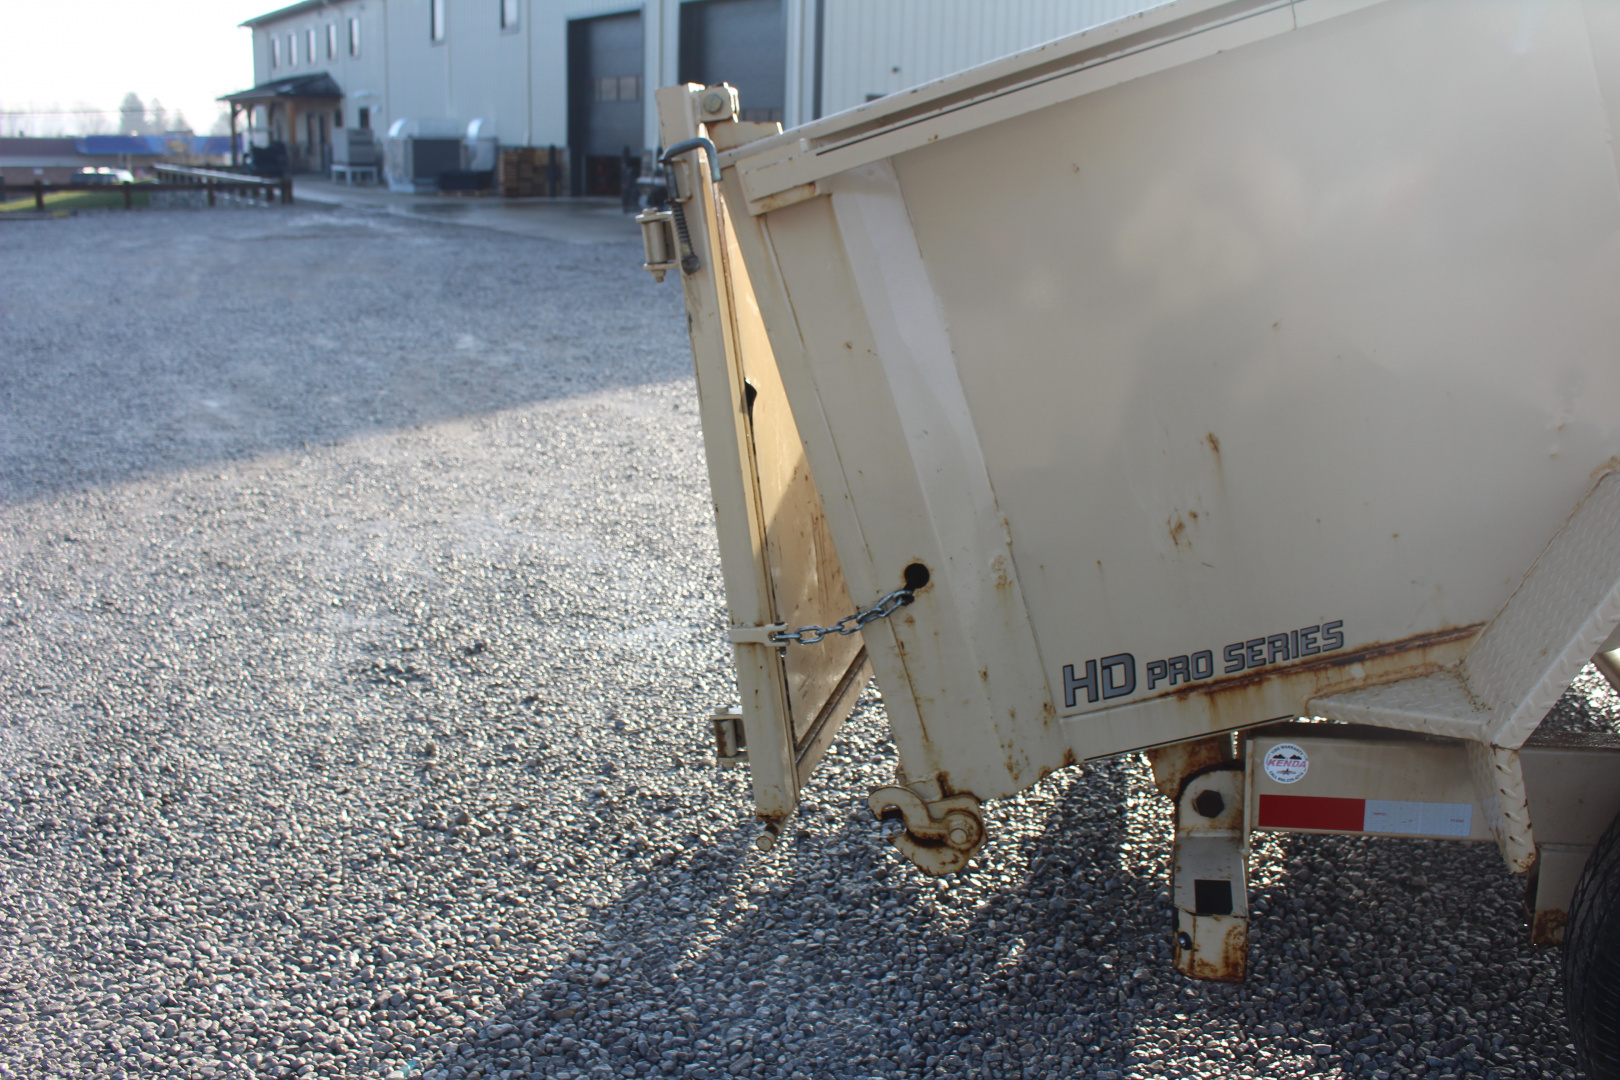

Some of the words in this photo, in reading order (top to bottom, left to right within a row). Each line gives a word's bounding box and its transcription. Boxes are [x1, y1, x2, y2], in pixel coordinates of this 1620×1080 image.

[1063, 653, 1136, 708] HD
[1146, 650, 1214, 690] PRO
[1223, 620, 1344, 674] SERIES
[1267, 759, 1306, 768] KENDA
